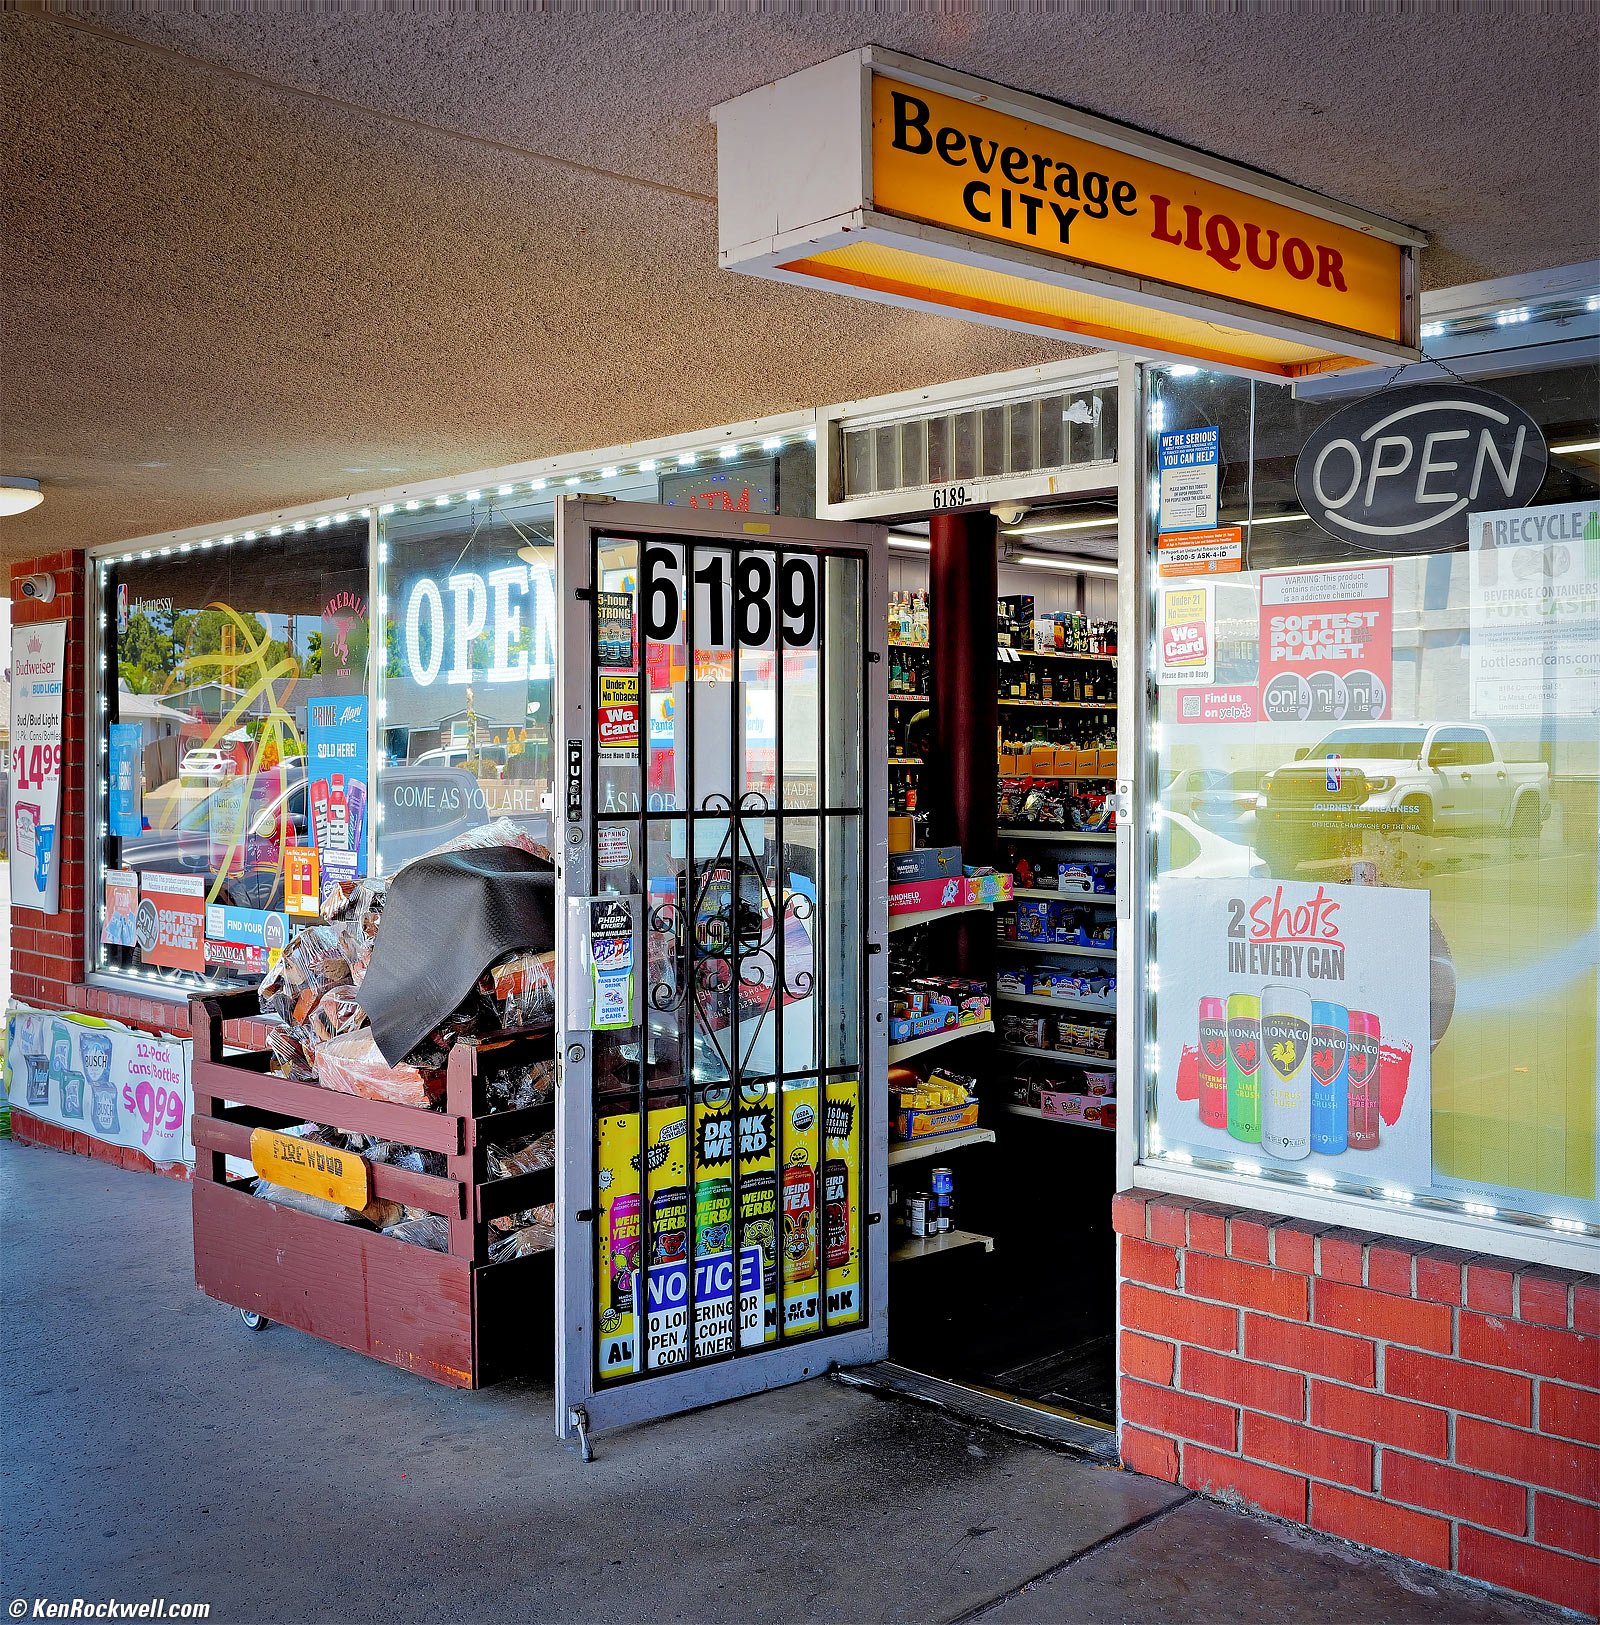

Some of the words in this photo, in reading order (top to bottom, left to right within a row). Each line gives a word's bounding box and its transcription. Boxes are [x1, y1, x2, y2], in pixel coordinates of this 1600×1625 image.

[891, 91, 1138, 219] Beverage
[963, 180, 1080, 244] CITY
[1149, 194, 1348, 292] LIQUOR
[1162, 434, 1184, 447] WE'RE
[1186, 431, 1217, 444] SERIOUS
[1164, 454, 1178, 465] YOU
[1180, 453, 1194, 464] CAN
[1196, 451, 1214, 462] HELP
[1312, 424, 1527, 509] OPEN
[1495, 512, 1583, 545] RECYCLE
[1170, 553, 1196, 561] 1-800-5
[1197, 551, 1227, 559] ASK-4-ID
[1284, 574, 1321, 585] WARNING:
[1322, 574, 1336, 582] This
[1337, 572, 1364, 583] product
[1280, 584, 1308, 594] contains
[1309, 583, 1339, 592] nicotine.
[1339, 581, 1369, 590] Nicotine
[1484, 587, 1533, 602] BEVERAGE
[1535, 583, 1598, 598] CONTAINERS
[598, 593, 629, 607] 5-hour
[646, 547, 817, 648] 6189
[1171, 595, 1191, 606] Under
[1192, 595, 1201, 605] 21
[1290, 594, 1299, 602] an
[1300, 592, 1330, 601] addictive
[1332, 590, 1365, 599] chemical.
[135, 596, 174, 614] Hennessy
[322, 591, 366, 624] FIREBALL
[1485, 600, 1529, 618] FOR
[598, 607, 631, 620] STRONG
[1270, 611, 1380, 632] SOFTEST
[405, 562, 556, 687] OPEN
[1170, 626, 1198, 642] We
[1270, 628, 1352, 647] POUCH
[1165, 637, 1205, 657] Card
[1270, 643, 1365, 662] PLANET.
[15, 658, 56, 676] Budweiser
[32, 683, 44, 694] BUD
[605, 679, 626, 690] Under
[627, 679, 636, 689] 21
[602, 692, 612, 702] No
[612, 691, 638, 702] Tobacco
[1204, 692, 1228, 703] Find
[1229, 694, 1242, 703] us
[313, 706, 337, 727] PRIME
[606, 708, 634, 723] We
[1204, 709, 1218, 717] on
[1219, 706, 1242, 720] yelp
[1268, 705, 1297, 713] PLUS
[17, 713, 42, 728] Bud/Bud
[42, 713, 59, 728] Light
[600, 722, 638, 737] Card
[317, 743, 337, 759] SOLD
[336, 743, 358, 758] HERE!
[214, 795, 241, 812] Hennessy
[394, 785, 436, 809] COME
[440, 786, 460, 810] AS
[464, 787, 496, 811] YOU
[501, 788, 539, 812] ARE.
[603, 791, 628, 813] AS
[1311, 803, 1353, 812] JOURNEY
[1353, 804, 1367, 812] TO
[1367, 804, 1420, 814] GREATNESS
[1311, 821, 1339, 829] OFFICIAL
[1340, 822, 1380, 830] CHAMPAGNE
[158, 909, 204, 927] SOFTEST
[597, 915, 628, 925] PHORM
[600, 922, 624, 930] ENERGY
[1227, 898, 1246, 939] 2
[159, 922, 194, 938] POUCH
[227, 920, 243, 931] FIND
[243, 922, 263, 935] YOUR
[267, 925, 281, 938] ZYN
[591, 930, 605, 938] NOW
[159, 933, 199, 951] PLANET.
[211, 944, 246, 961] SENECA
[1228, 941, 1246, 974] IN
[1249, 943, 1305, 978] EVERY
[1307, 946, 1345, 981] CAN
[605, 1012, 622, 1020] CANS
[1263, 1026, 1309, 1041] MONACO
[1311, 1036, 1346, 1050] ONACO
[1348, 1042, 1378, 1055] ONACO
[85, 1055, 108, 1068] BUSCH
[136, 1043, 171, 1064] 12-Pack
[128, 1060, 181, 1085] Cans/Bottles
[1235, 1090, 1261, 1099] CRUSH
[1269, 1088, 1301, 1099] CITRUS
[1314, 1092, 1335, 1102] BLUE
[97, 1102, 114, 1116] BUSCH
[1311, 1100, 1338, 1109] CRUSH
[704, 1114, 767, 1141] DRNK
[741, 1188, 774, 1206] WEIRD
[783, 1192, 811, 1213] TEA
[655, 1204, 687, 1220] WEIRD
[696, 1197, 731, 1214] WEIRD
[615, 1213, 640, 1228] WEIR
[648, 1256, 755, 1306] NOTICE
[665, 1300, 733, 1330] LOIERING
[741, 1295, 758, 1312] OR
[789, 1300, 802, 1313] OF
[787, 1309, 805, 1322] THE
[657, 1336, 741, 1366] CONAINER
